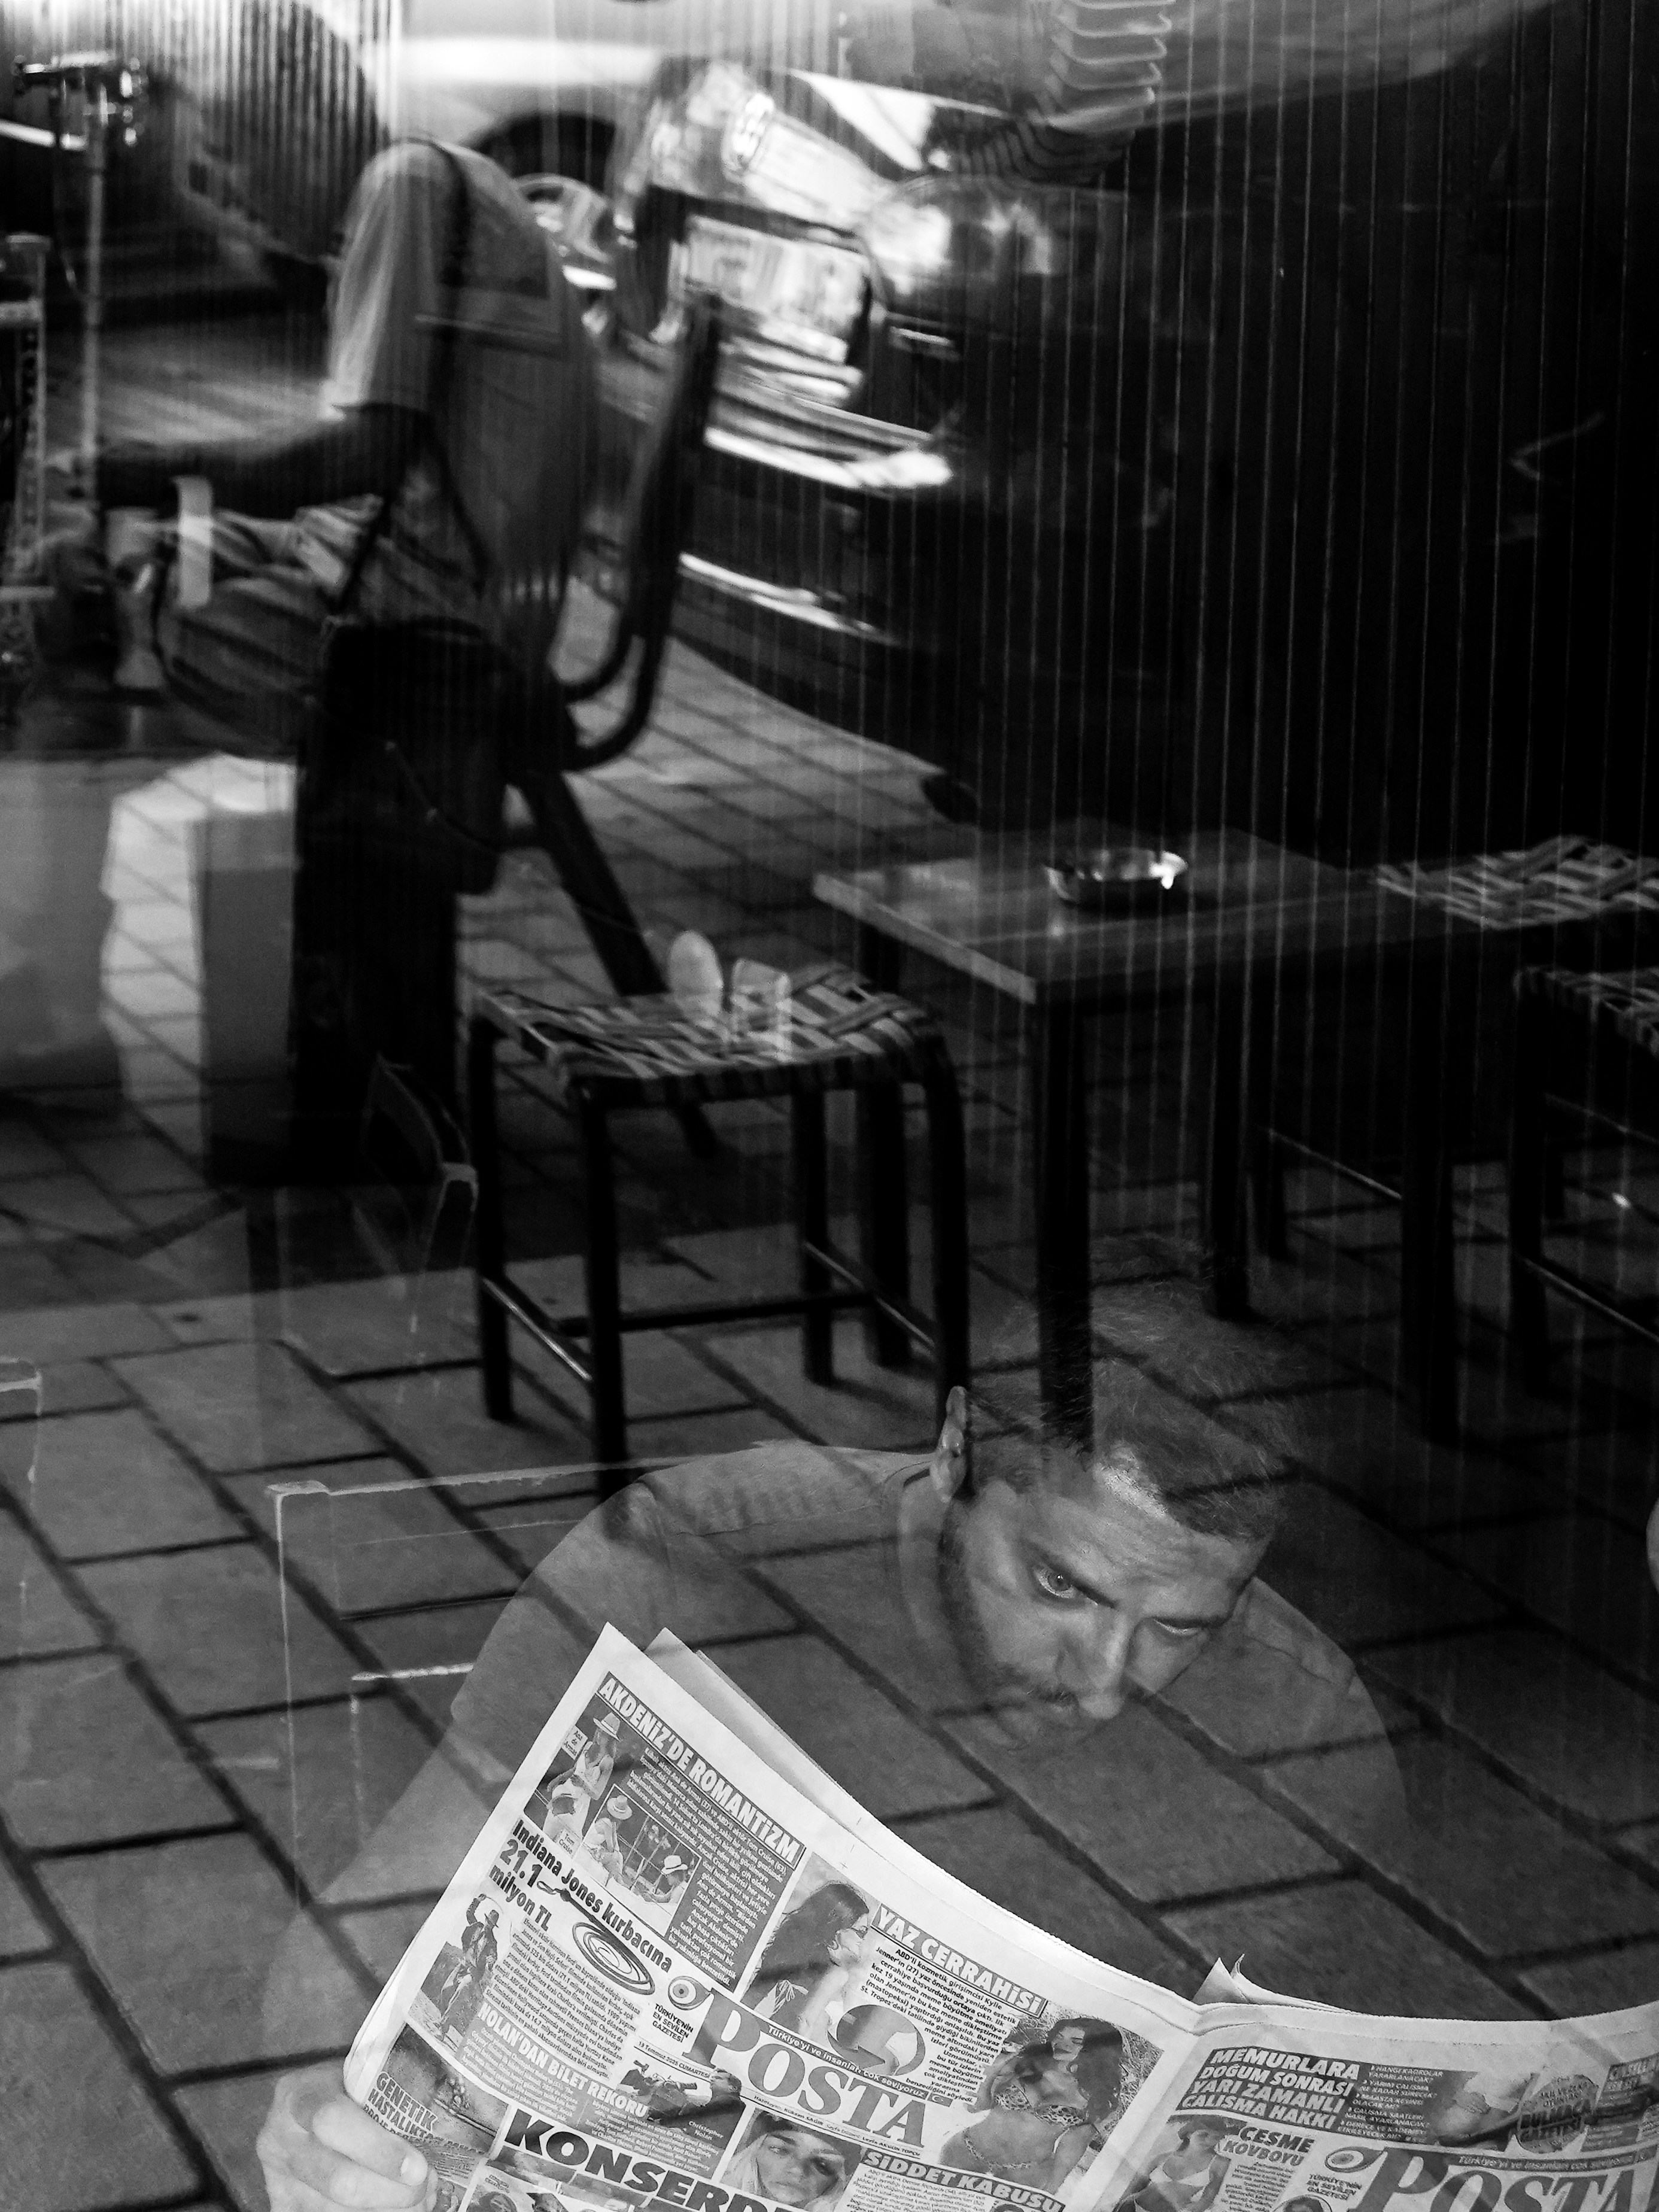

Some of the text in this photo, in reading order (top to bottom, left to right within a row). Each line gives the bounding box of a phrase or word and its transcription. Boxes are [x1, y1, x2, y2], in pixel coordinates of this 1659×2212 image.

[598, 1678, 800, 1859] AKDENİZ'DE ROMANTİZM
[500, 1839, 542, 1888] 21.1
[489, 1864, 552, 1931] milyon TL
[513, 1819, 673, 1973] Indiana Jones kırbacına
[874, 1907, 1040, 2014] YAZ CERRAHİSİ
[652, 2012, 689, 2038] EN SEVİLEN
[652, 2020, 684, 2043] GAZETESİ
[476, 2001, 550, 2068] NOLAN'DAN
[546, 2059, 588, 2089] BİLET
[586, 2080, 649, 2119] REKORU
[678, 2062, 711, 2079] CUMARTESİ
[682, 1989, 923, 2149] POSTA
[810, 2047, 822, 2057] ve
[880, 2077, 923, 2097] seviyoruz
[1199, 2064, 1271, 2083] DOĞUM
[1270, 2071, 1354, 2096] SONRASI
[1210, 2048, 1360, 2081] MEMURLARA
[376, 2073, 437, 2131] GENETİK
[1190, 2079, 1243, 2094] YARI
[1242, 2083, 1345, 2113] ZAMANLI
[1269, 2104, 1336, 2129] HAKKI
[505, 2109, 800, 2212] KONSERD
[1223, 2141, 1305, 2167] KOVBOYU
[958, 2175, 1062, 2212] KABUSU
